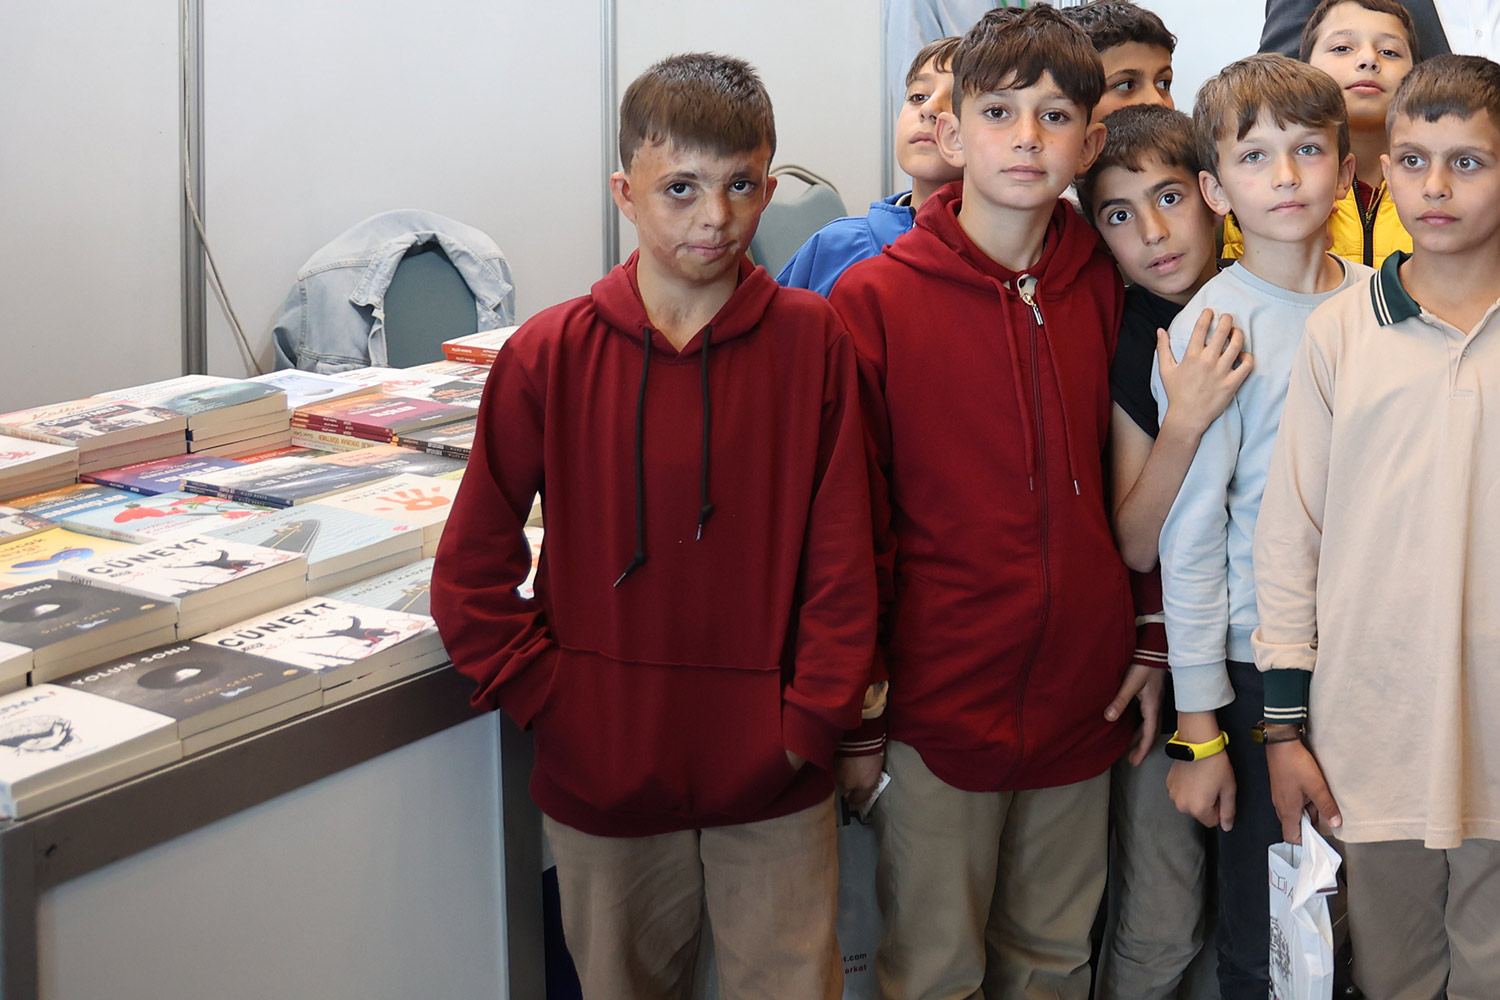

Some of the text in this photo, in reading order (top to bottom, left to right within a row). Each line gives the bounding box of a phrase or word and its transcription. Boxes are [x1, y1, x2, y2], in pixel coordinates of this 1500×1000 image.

[87, 537, 208, 575] CÜNEYT
[217, 602, 337, 648] CÜNEYT
[70, 644, 191, 687] YOLUN SONU
